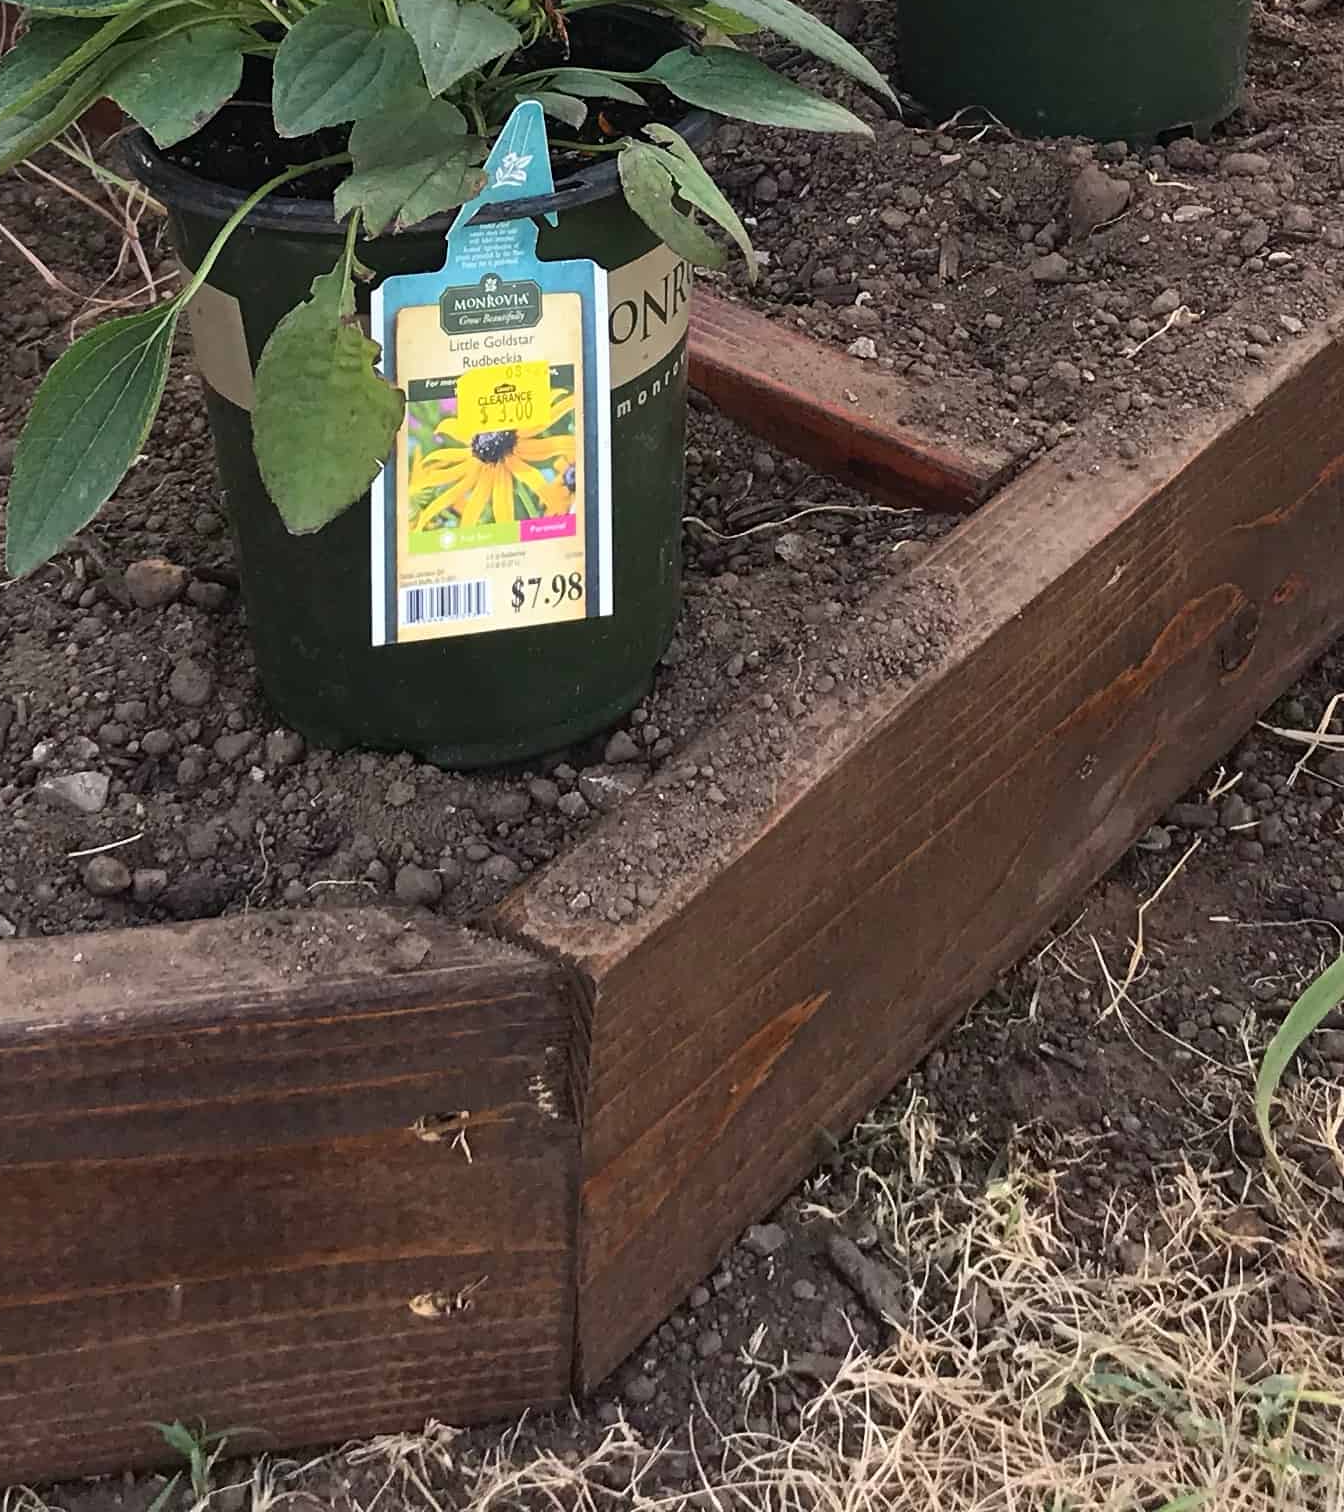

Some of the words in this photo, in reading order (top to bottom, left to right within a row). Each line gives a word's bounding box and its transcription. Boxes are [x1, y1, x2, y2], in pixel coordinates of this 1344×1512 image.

[454, 292, 530, 311] MONROVIA
[608, 260, 691, 345] ONR
[449, 337, 480, 352] Little
[483, 334, 535, 349] Goldstar
[462, 352, 523, 369] Rudbeckia
[478, 390, 533, 407] CLEARANCE
[510, 571, 583, 613] $7.98
